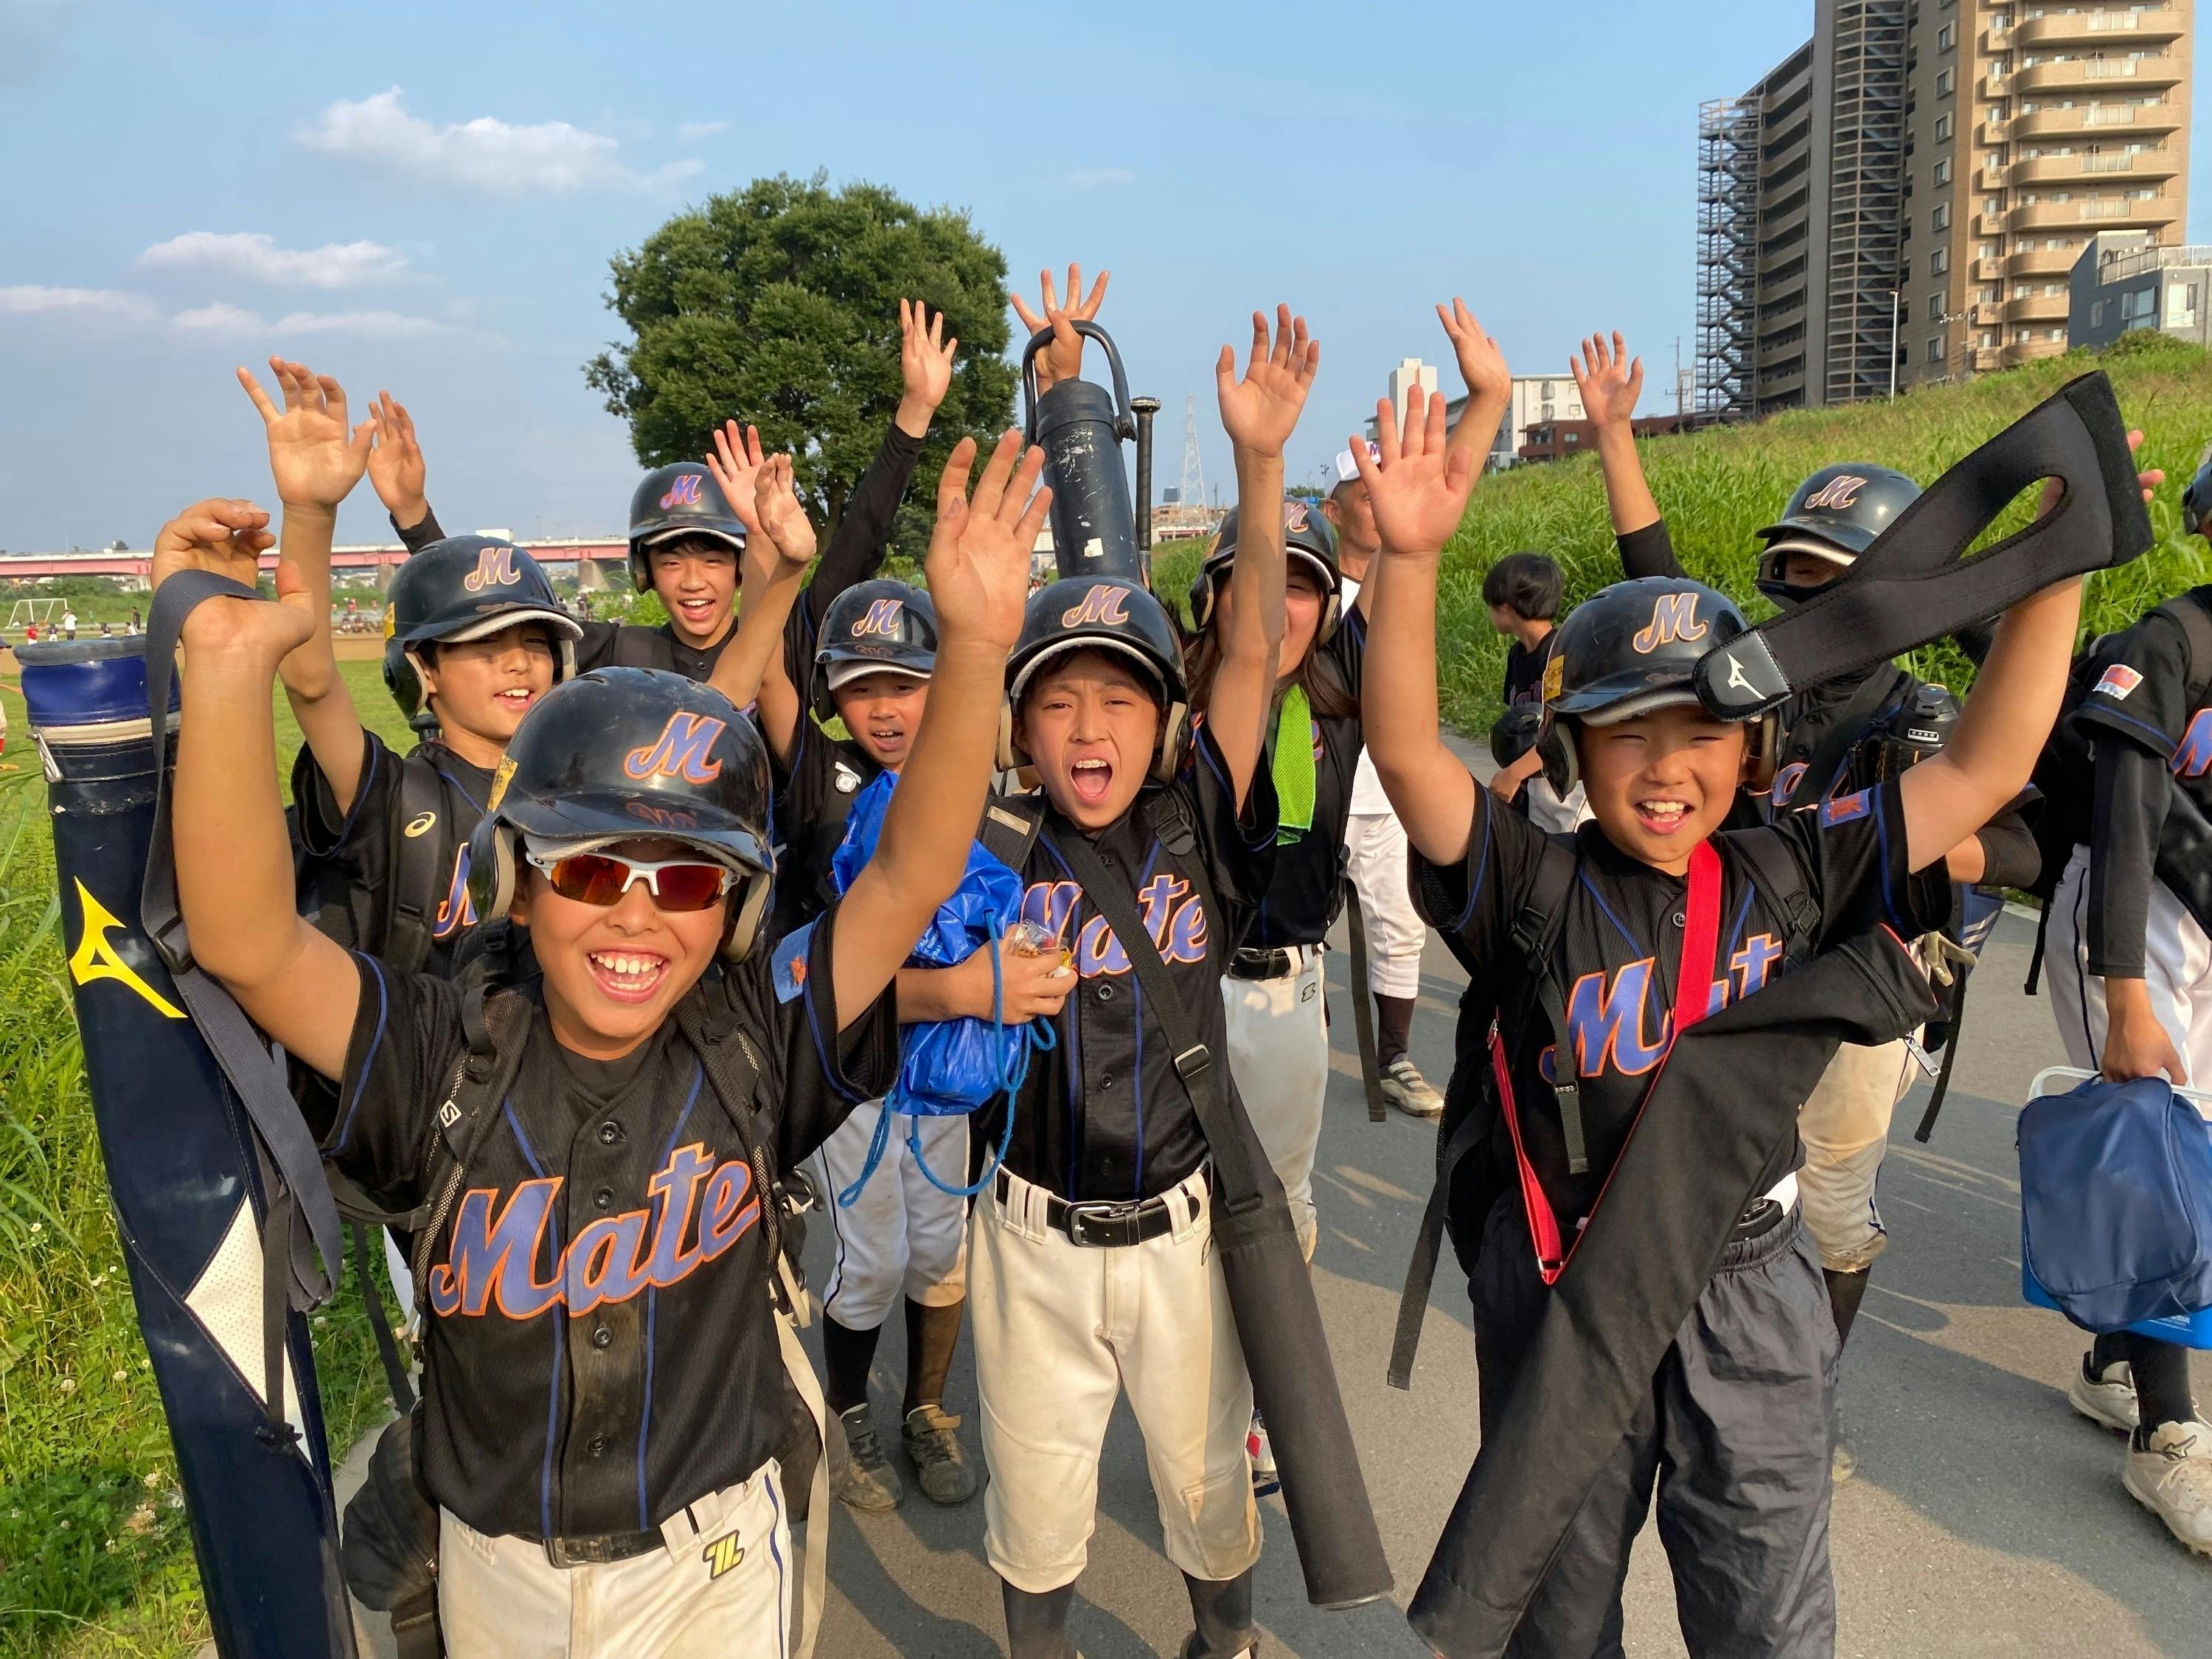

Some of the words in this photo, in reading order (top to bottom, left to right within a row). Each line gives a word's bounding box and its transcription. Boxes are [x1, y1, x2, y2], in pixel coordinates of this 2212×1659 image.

[660, 474, 702, 510] M
[1804, 476, 1868, 509] M
[464, 547, 521, 592] M
[852, 599, 904, 637] M
[1061, 584, 1130, 629] M
[1632, 592, 1708, 654] M
[623, 710, 728, 785] M
[1539, 933, 1783, 1084] Mt
[429, 1141, 762, 1319] Mate
